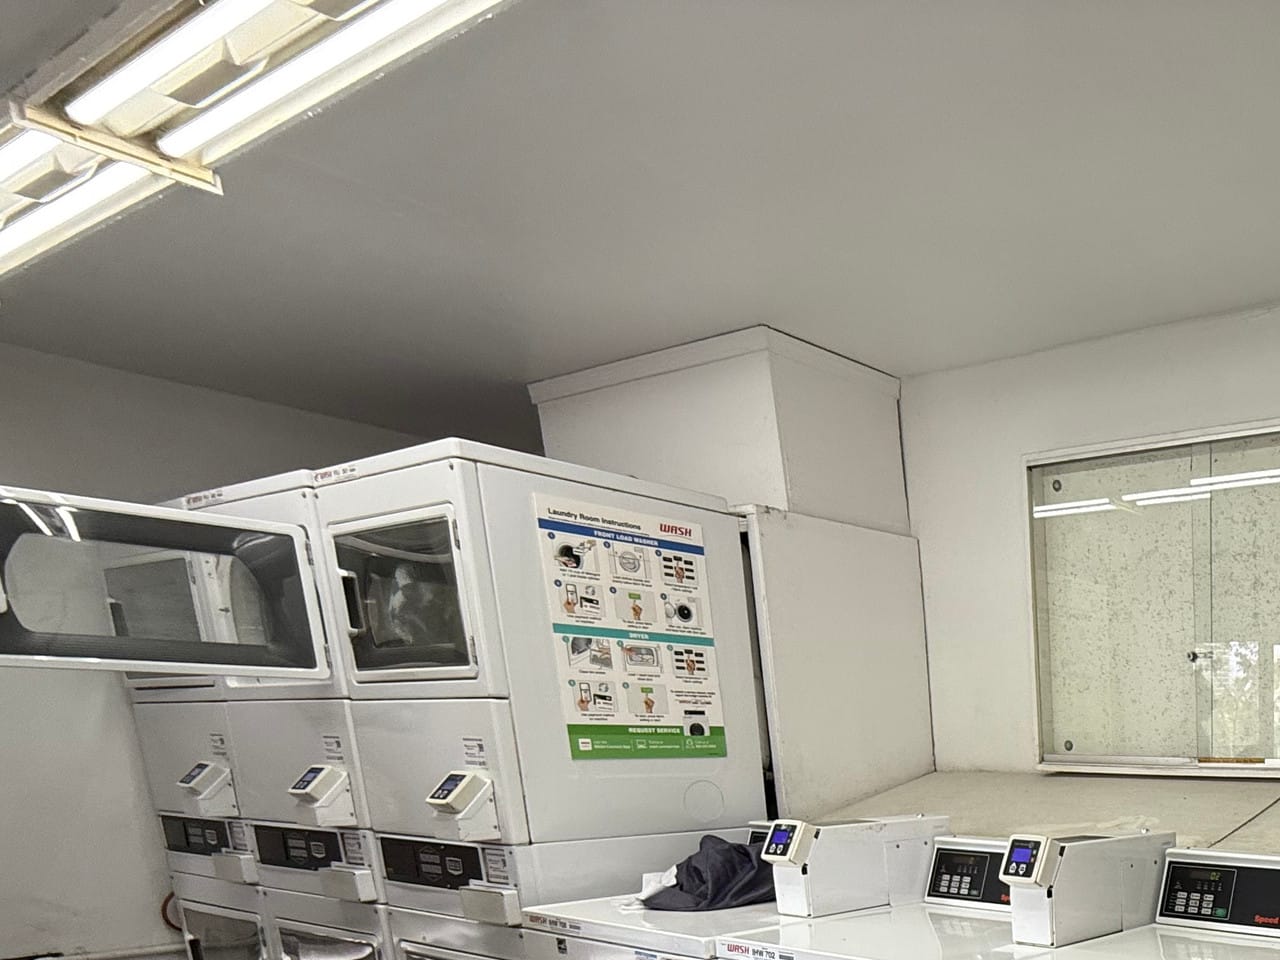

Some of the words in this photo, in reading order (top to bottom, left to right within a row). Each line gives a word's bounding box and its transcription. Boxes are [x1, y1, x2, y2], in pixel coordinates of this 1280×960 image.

[547, 507, 577, 520] Laundry
[579, 513, 600, 523] Room
[601, 517, 641, 530] Instructions
[659, 523, 692, 537] WASH
[616, 533, 633, 543] LOAD
[1254, 914, 1279, 925] Speed
[727, 943, 750, 955] WASH
[764, 950, 776, 960] 702
